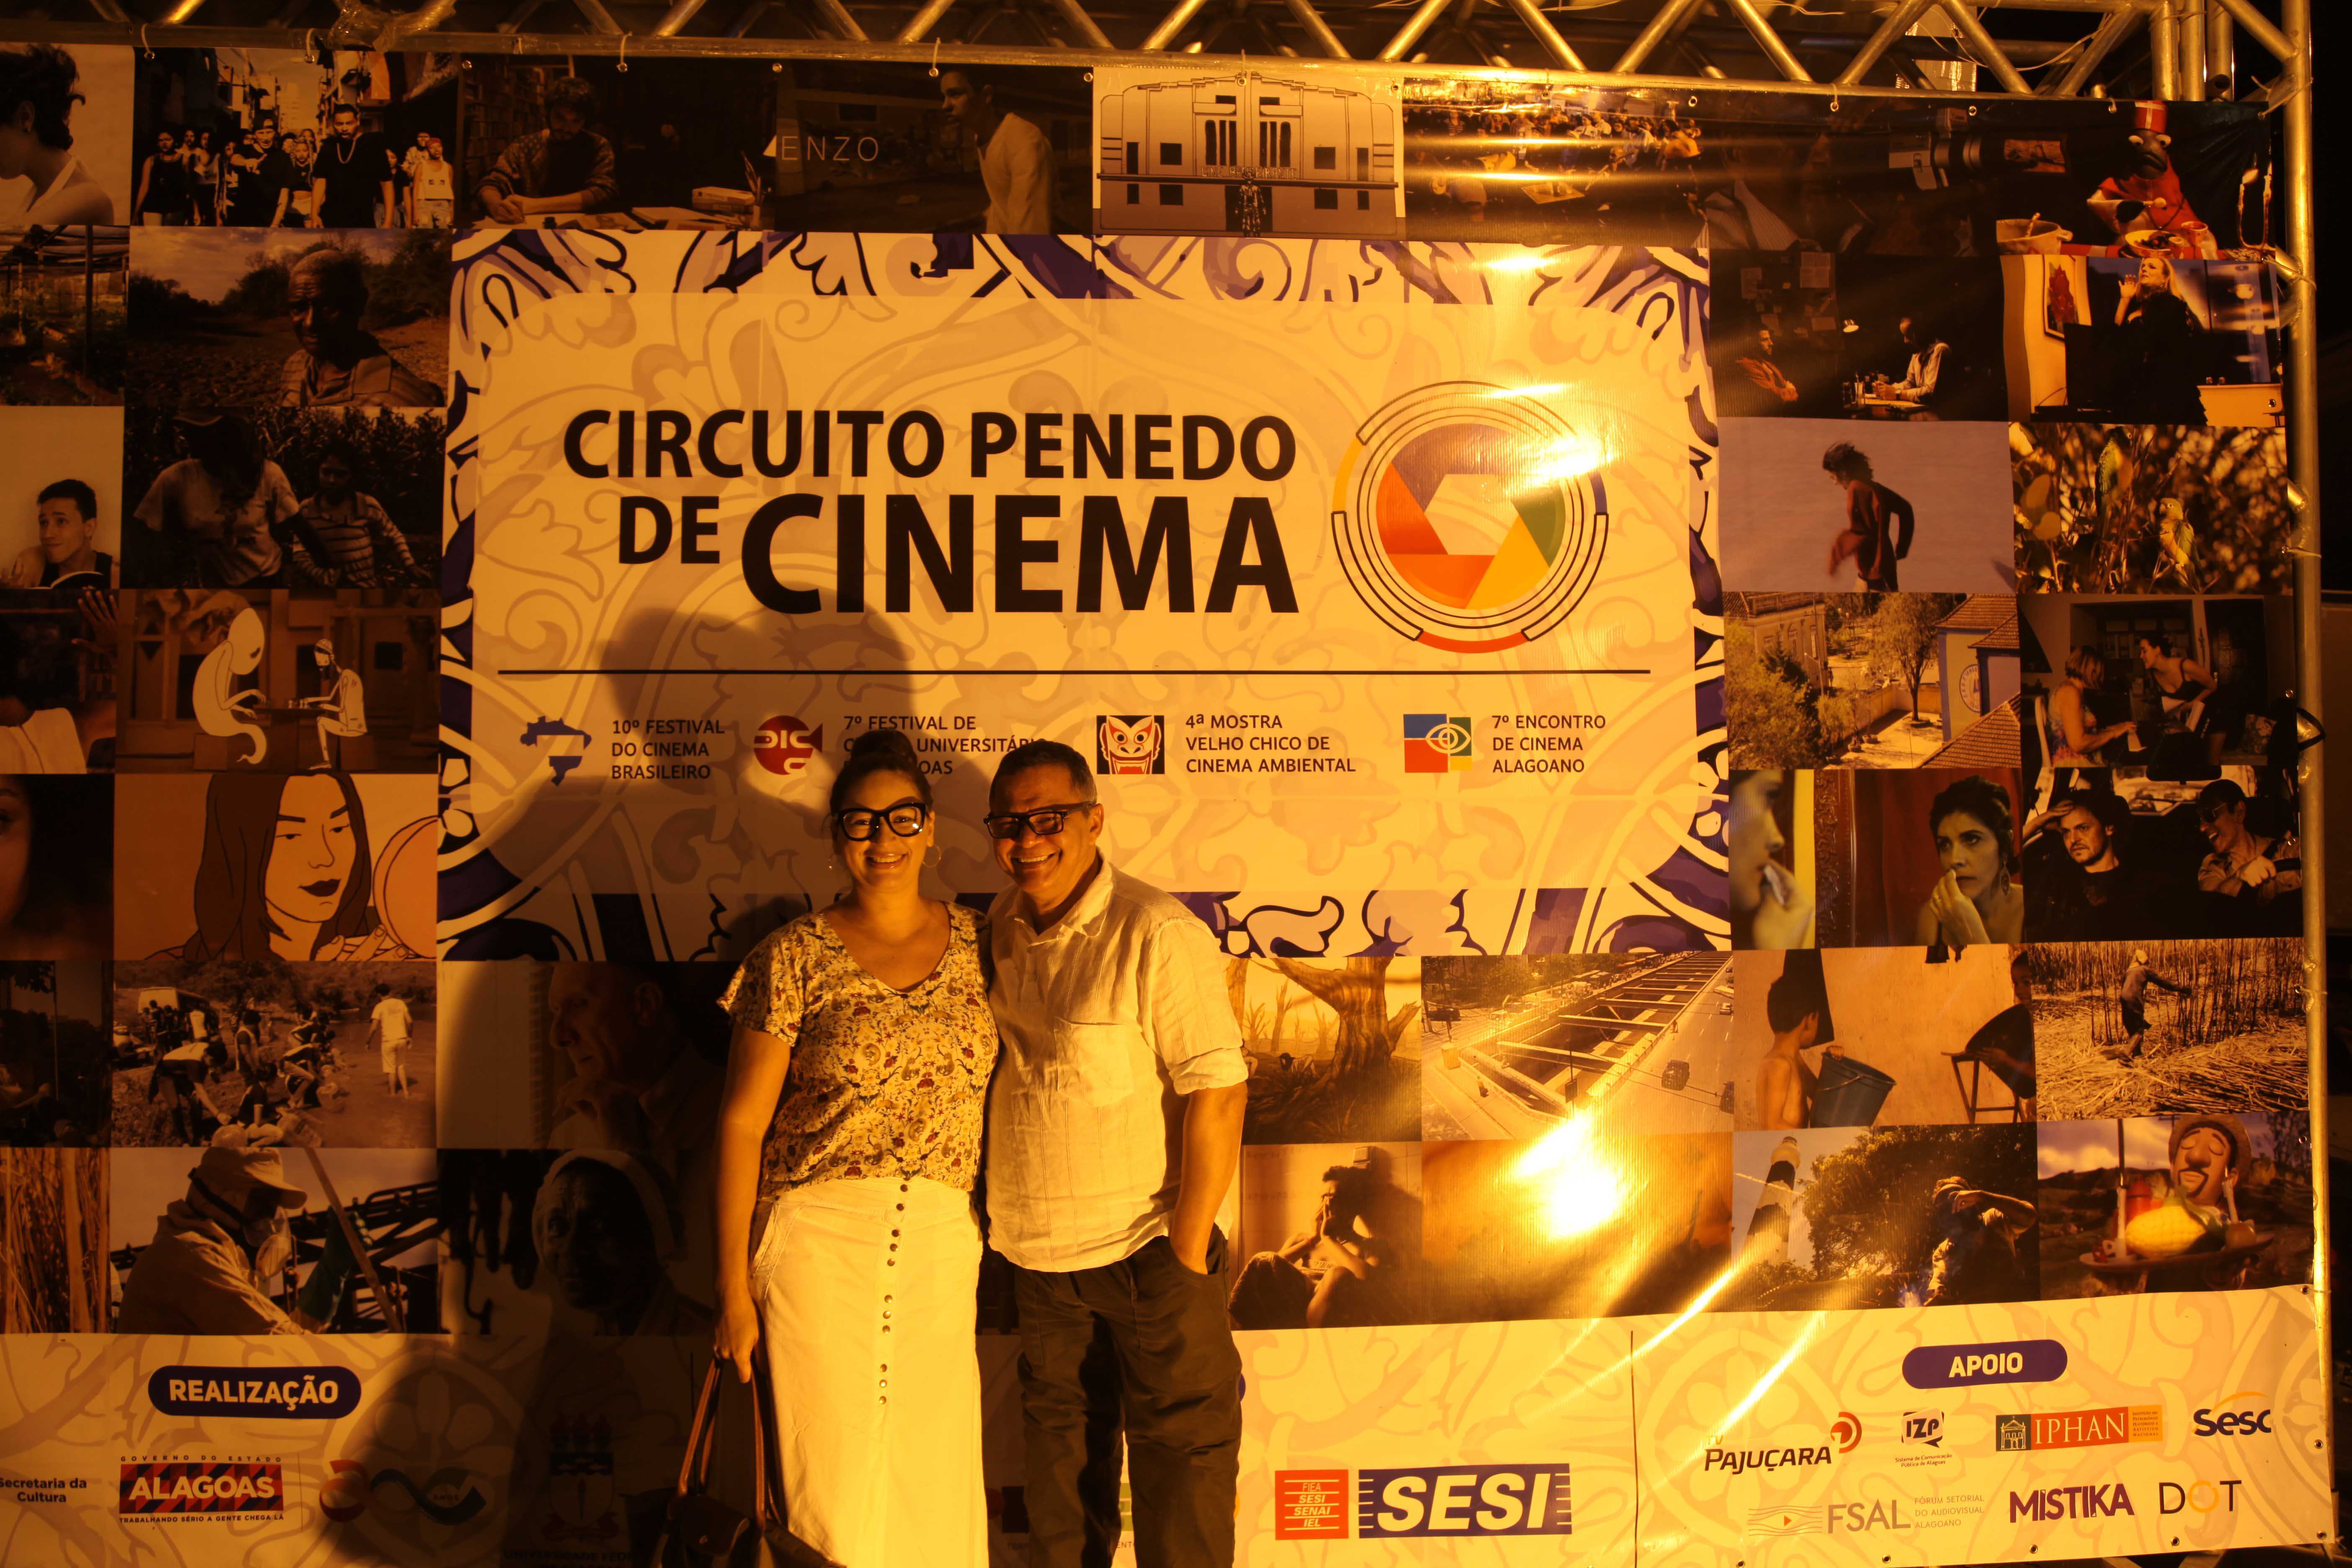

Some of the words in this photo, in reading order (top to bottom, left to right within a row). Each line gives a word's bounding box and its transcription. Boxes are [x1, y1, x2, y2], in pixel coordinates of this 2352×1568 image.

[781, 136, 878, 162] ENZO
[564, 409, 944, 478] CIRCUITO
[971, 412, 1296, 481] PENEDO
[619, 496, 720, 564] DE
[742, 493, 1299, 614] CINEMA
[646, 720, 725, 734] FESTIVAL
[869, 716, 947, 730] FESTIVAL
[954, 716, 976, 730] DE
[1211, 714, 1282, 729] MOSTRA
[1516, 715, 1606, 729] ENCONTRO
[612, 743, 636, 756] DO
[642, 742, 709, 756] CINEMA
[1186, 737, 1243, 750] VELHO
[1249, 736, 1301, 750] CHICO
[1308, 736, 1330, 750] DE
[1493, 737, 1514, 750] DE
[1520, 737, 1583, 750] CINEMA
[612, 765, 710, 779] BRASILEIRO
[1186, 759, 1252, 773] CINEMA
[1259, 758, 1356, 772] AMBIENTAL
[1493, 759, 1584, 773] ALAGOANO
[1949, 1352, 2022, 1378] APOIO
[169, 1374, 338, 1411] REALIZAÇÃO
[1906, 1418, 1939, 1438] IZP
[2034, 1413, 2125, 1444] IPHAN
[1705, 1447, 1831, 1475] PAJUÇARA
[70, 1478, 87, 1488] da
[129, 1475, 275, 1500] ALAGOAS
[1302, 1483, 1321, 1491] FIEA
[17, 1491, 67, 1502] Cultura
[1299, 1494, 1326, 1504] SESI
[1377, 1473, 1551, 1532] SESI
[1915, 1496, 1943, 1504] FÓRUM
[2010, 1483, 2135, 1523] MISTIKA
[2159, 1480, 2242, 1514] DOT
[1293, 1506, 1331, 1516] SENAI
[1828, 1499, 1911, 1533] FSAL
[1931, 1507, 1984, 1516] AUDIOVISUAL
[1303, 1518, 1320, 1527] IEL
[1915, 1519, 1961, 1528] ALAGOANO
